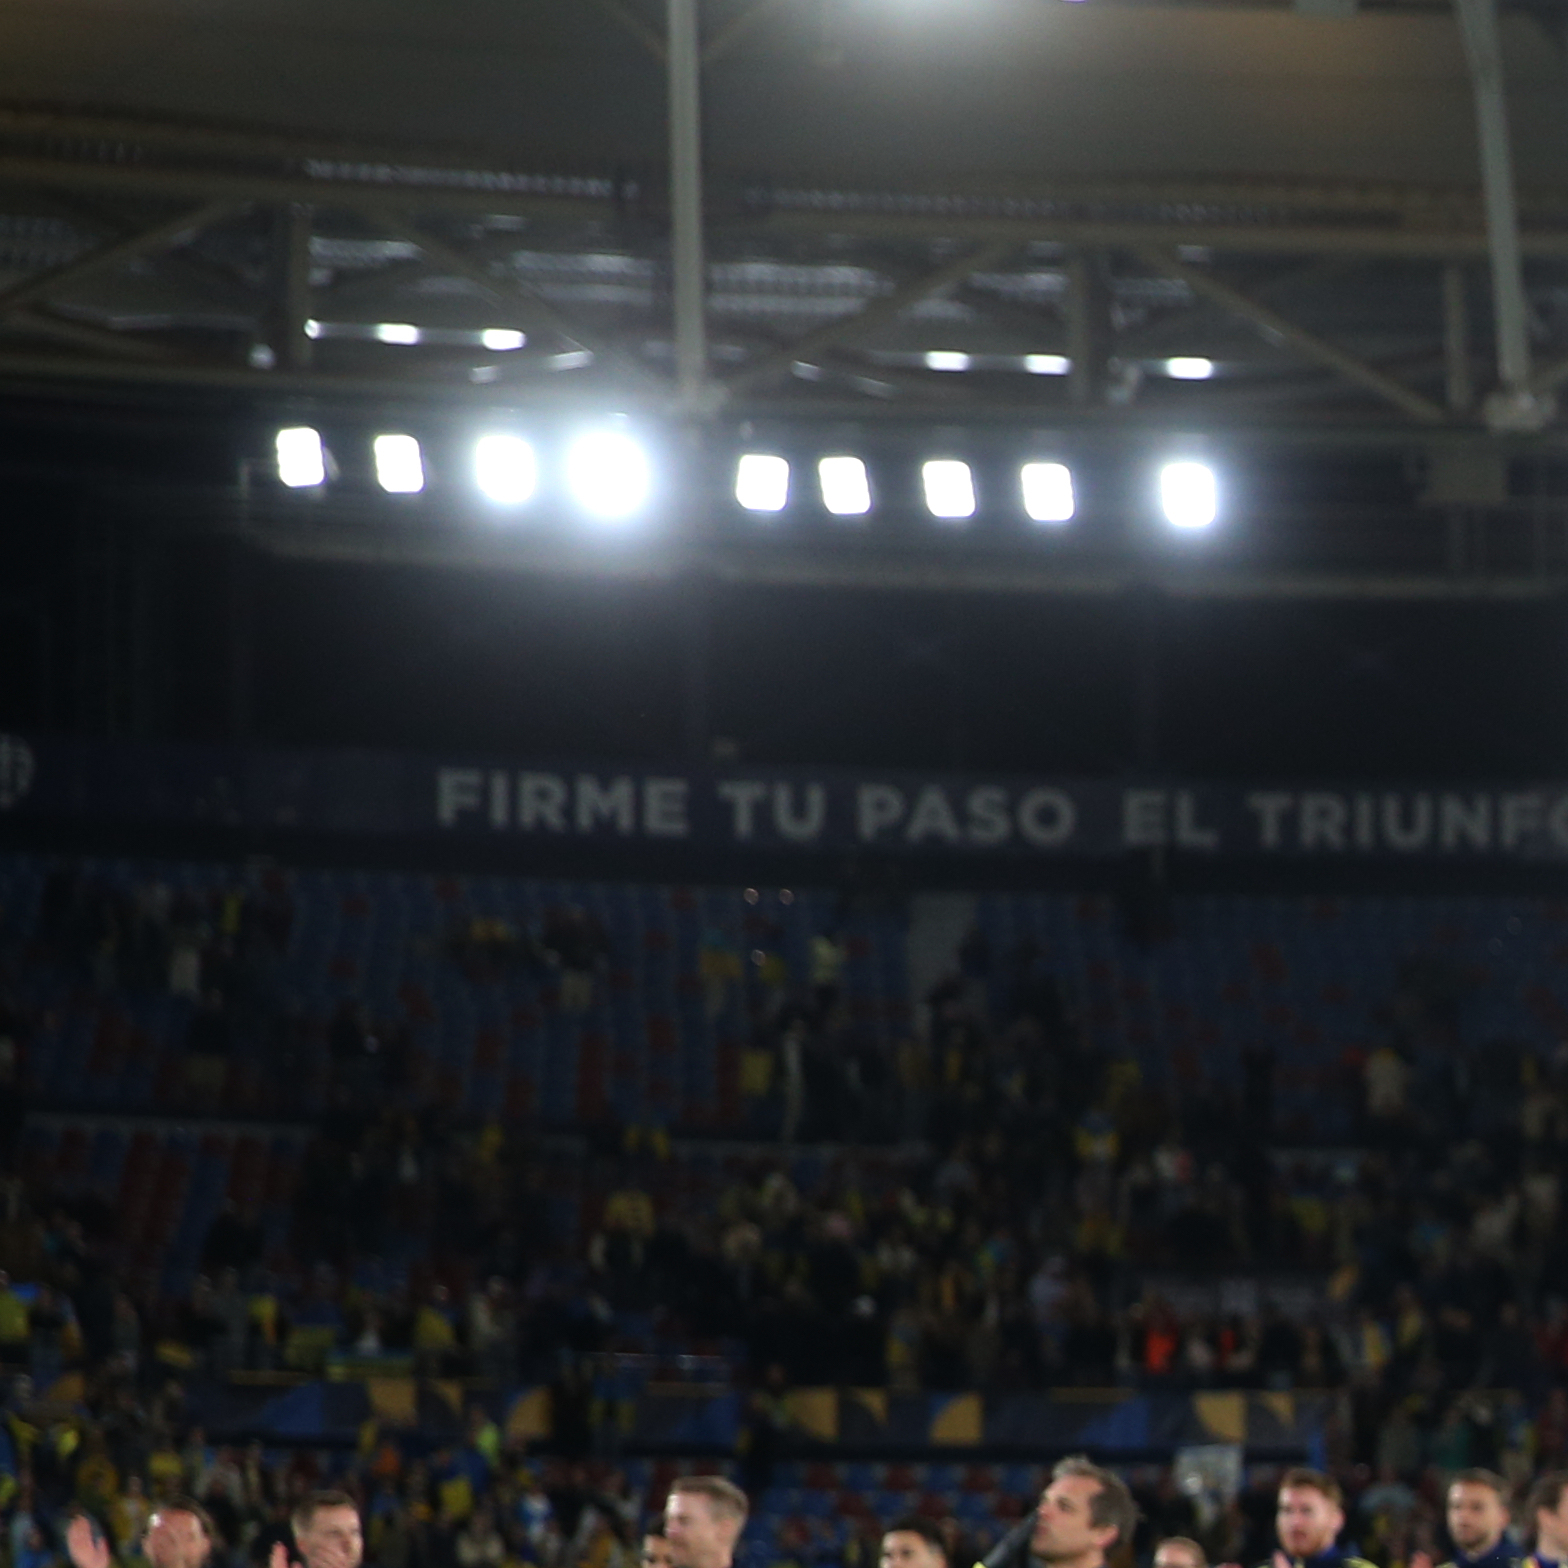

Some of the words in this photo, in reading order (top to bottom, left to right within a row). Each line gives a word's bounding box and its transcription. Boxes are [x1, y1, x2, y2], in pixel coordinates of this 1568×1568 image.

[436, 767, 690, 838] FIRME
[717, 779, 824, 842] TU
[855, 783, 1078, 846] PASO
[1121, 788, 1218, 848] EL
